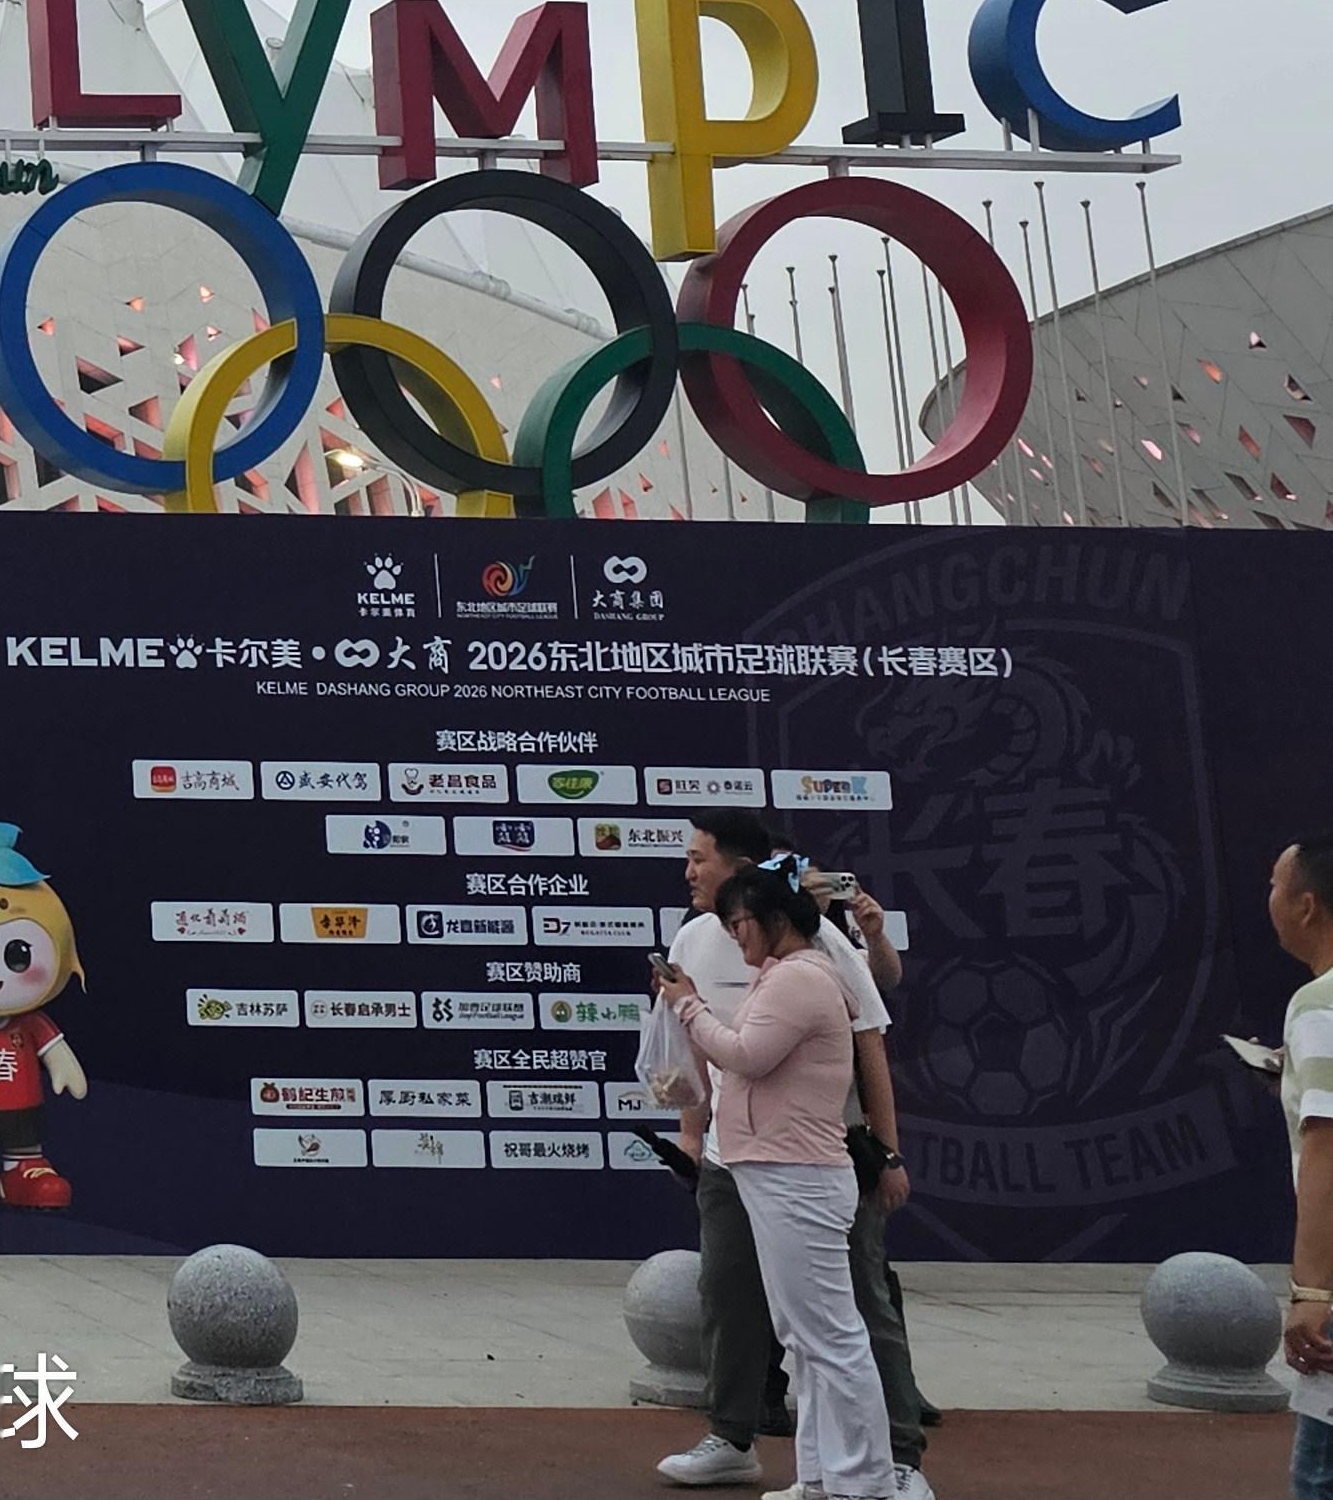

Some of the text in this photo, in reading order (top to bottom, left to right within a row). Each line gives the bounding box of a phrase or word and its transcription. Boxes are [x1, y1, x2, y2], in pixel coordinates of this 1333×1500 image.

[357, 592, 415, 605] KELME
[592, 589, 665, 610] 大商集团
[6, 636, 166, 668] KELME
[206, 636, 303, 669] 卡尔美
[386, 634, 453, 675] 大商
[256, 681, 771, 702] KELME DASHANG GROUP 2026 NORTHEAST CITY FOOTBALL LEAGUE
[435, 729, 600, 754] 赛区战略合作伙伴
[428, 773, 498, 789] 老昌食品
[628, 827, 684, 845] 东北振兴
[855, 777, 1134, 940] 长春
[465, 872, 590, 896] 赛区合作企业
[485, 961, 581, 983] 赛区赞助商
[473, 1048, 607, 1071] 赛区全民超赞官
[503, 1141, 591, 1160] 祝哥最火烧烤
[1064, 1112, 1207, 1192] TEAM
